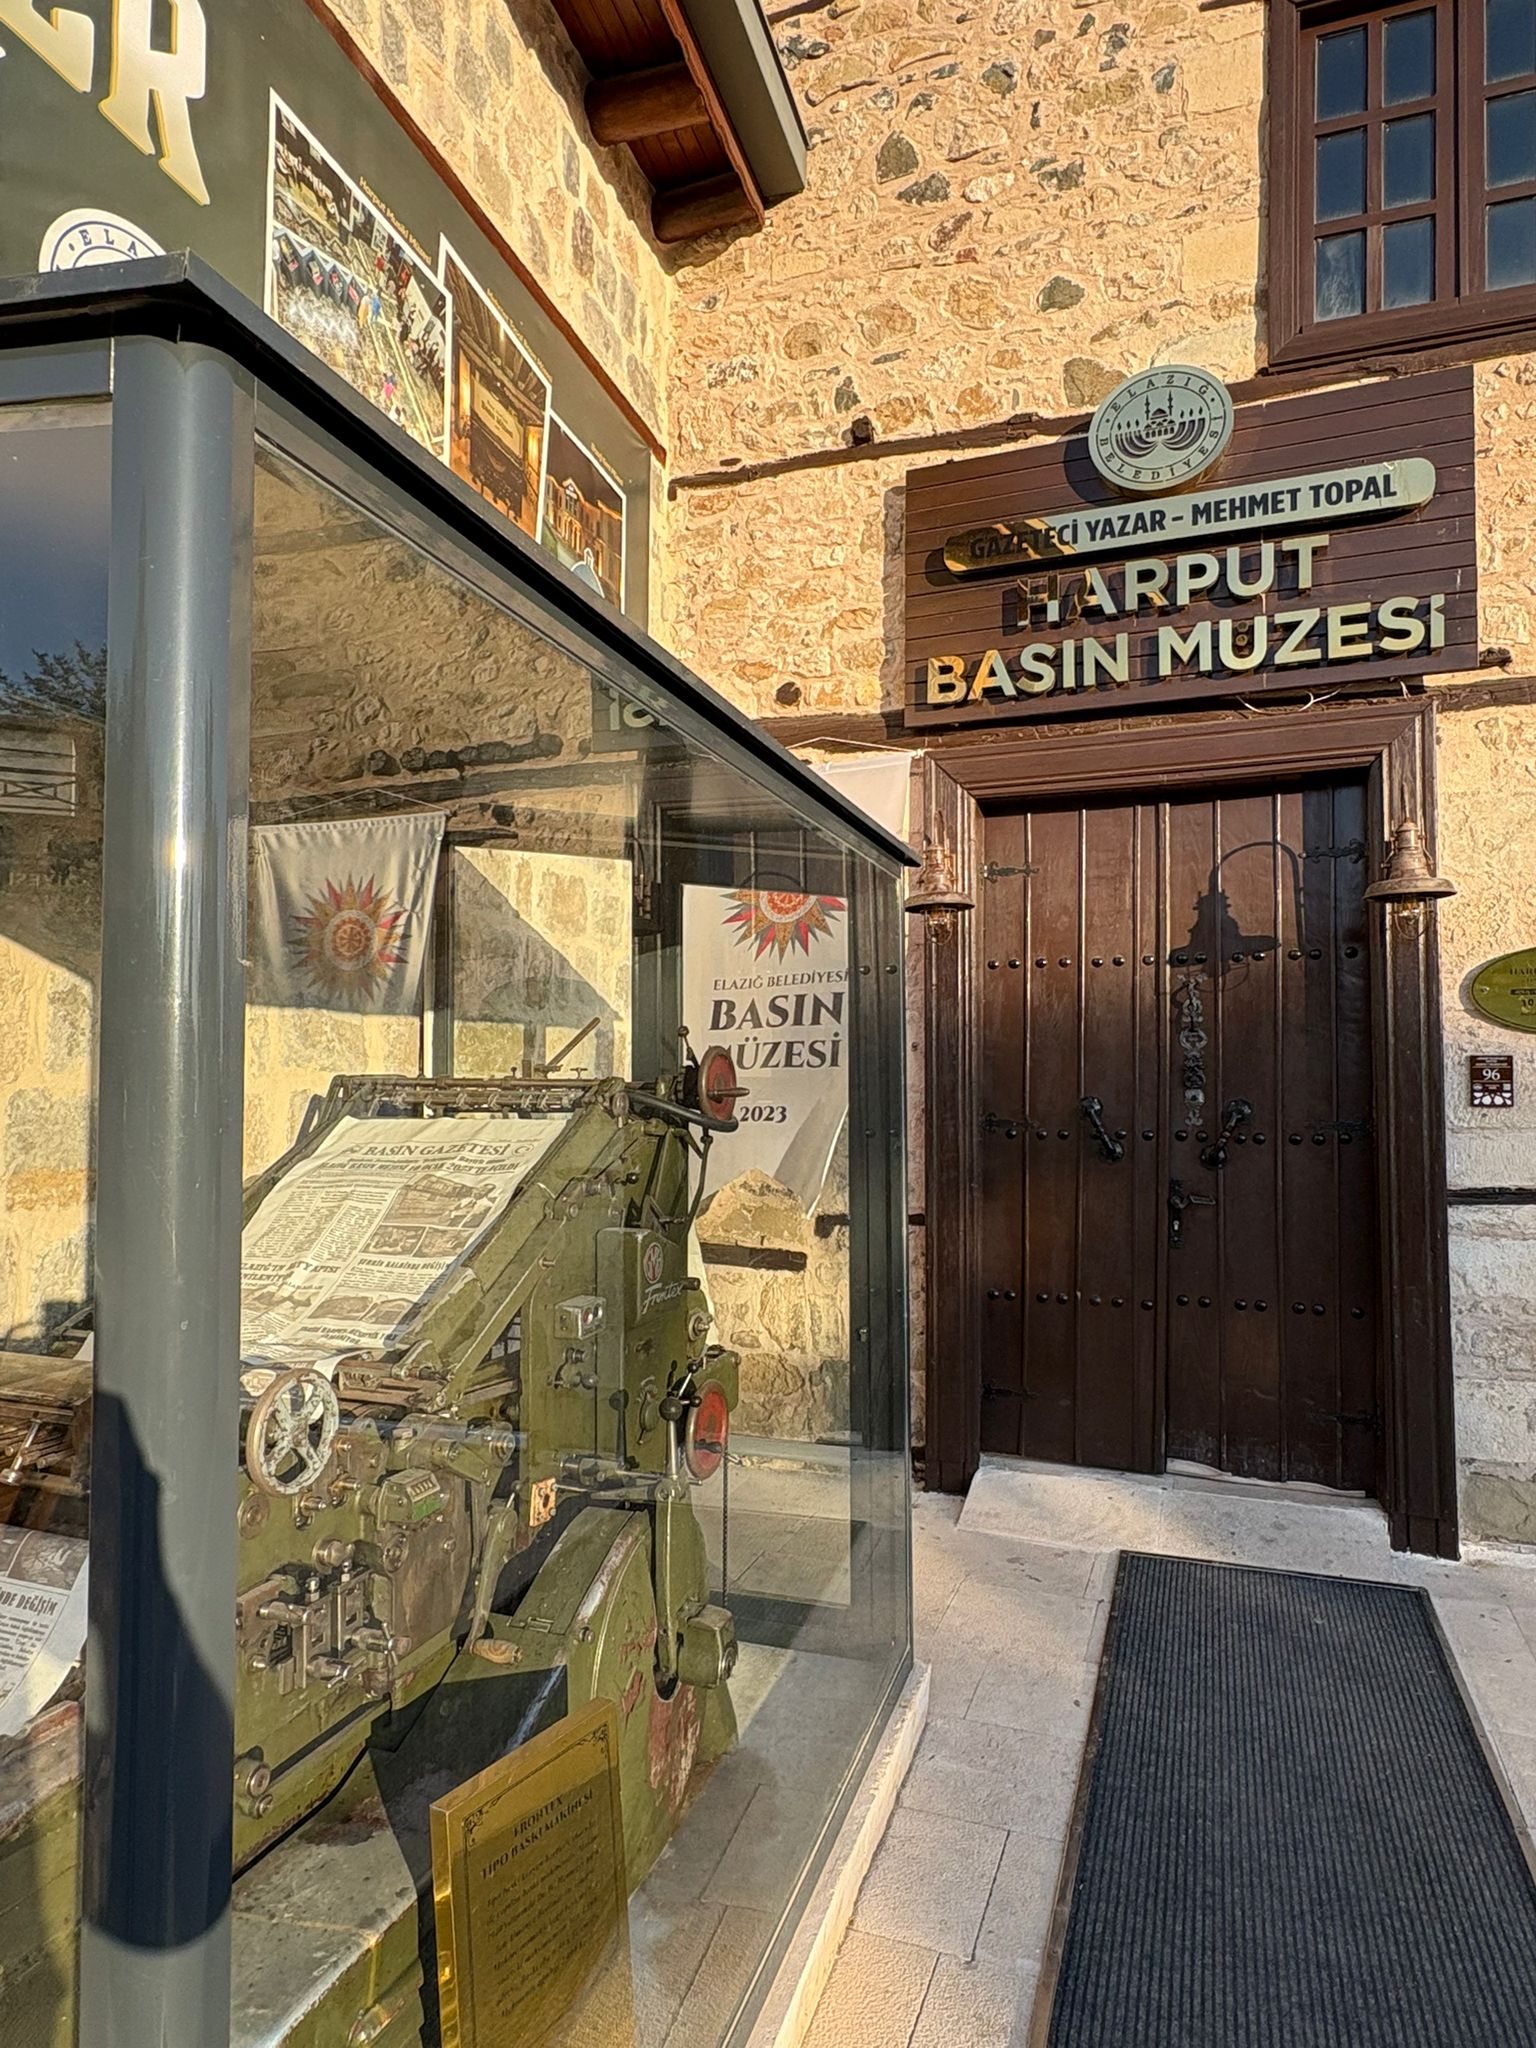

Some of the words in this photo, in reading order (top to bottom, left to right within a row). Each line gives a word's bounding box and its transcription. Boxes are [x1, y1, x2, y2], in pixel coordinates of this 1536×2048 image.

[969, 518, 1079, 559] GAZETECİ
[1085, 509, 1167, 542] YAZAR
[1191, 487, 1301, 527] MEHMET
[1309, 473, 1397, 509] TOPAL
[1015, 534, 1331, 627] HARPUT
[926, 631, 1129, 705] BASIN
[713, 975, 764, 991] ELAZIĞ
[708, 991, 846, 1031] BASIN
[708, 1031, 842, 1070] ÜZESİ
[1482, 1068, 1501, 1081] 96
[739, 1105, 788, 1124] 2023
[15, 1594, 58, 1616] DEĞİŞİM
